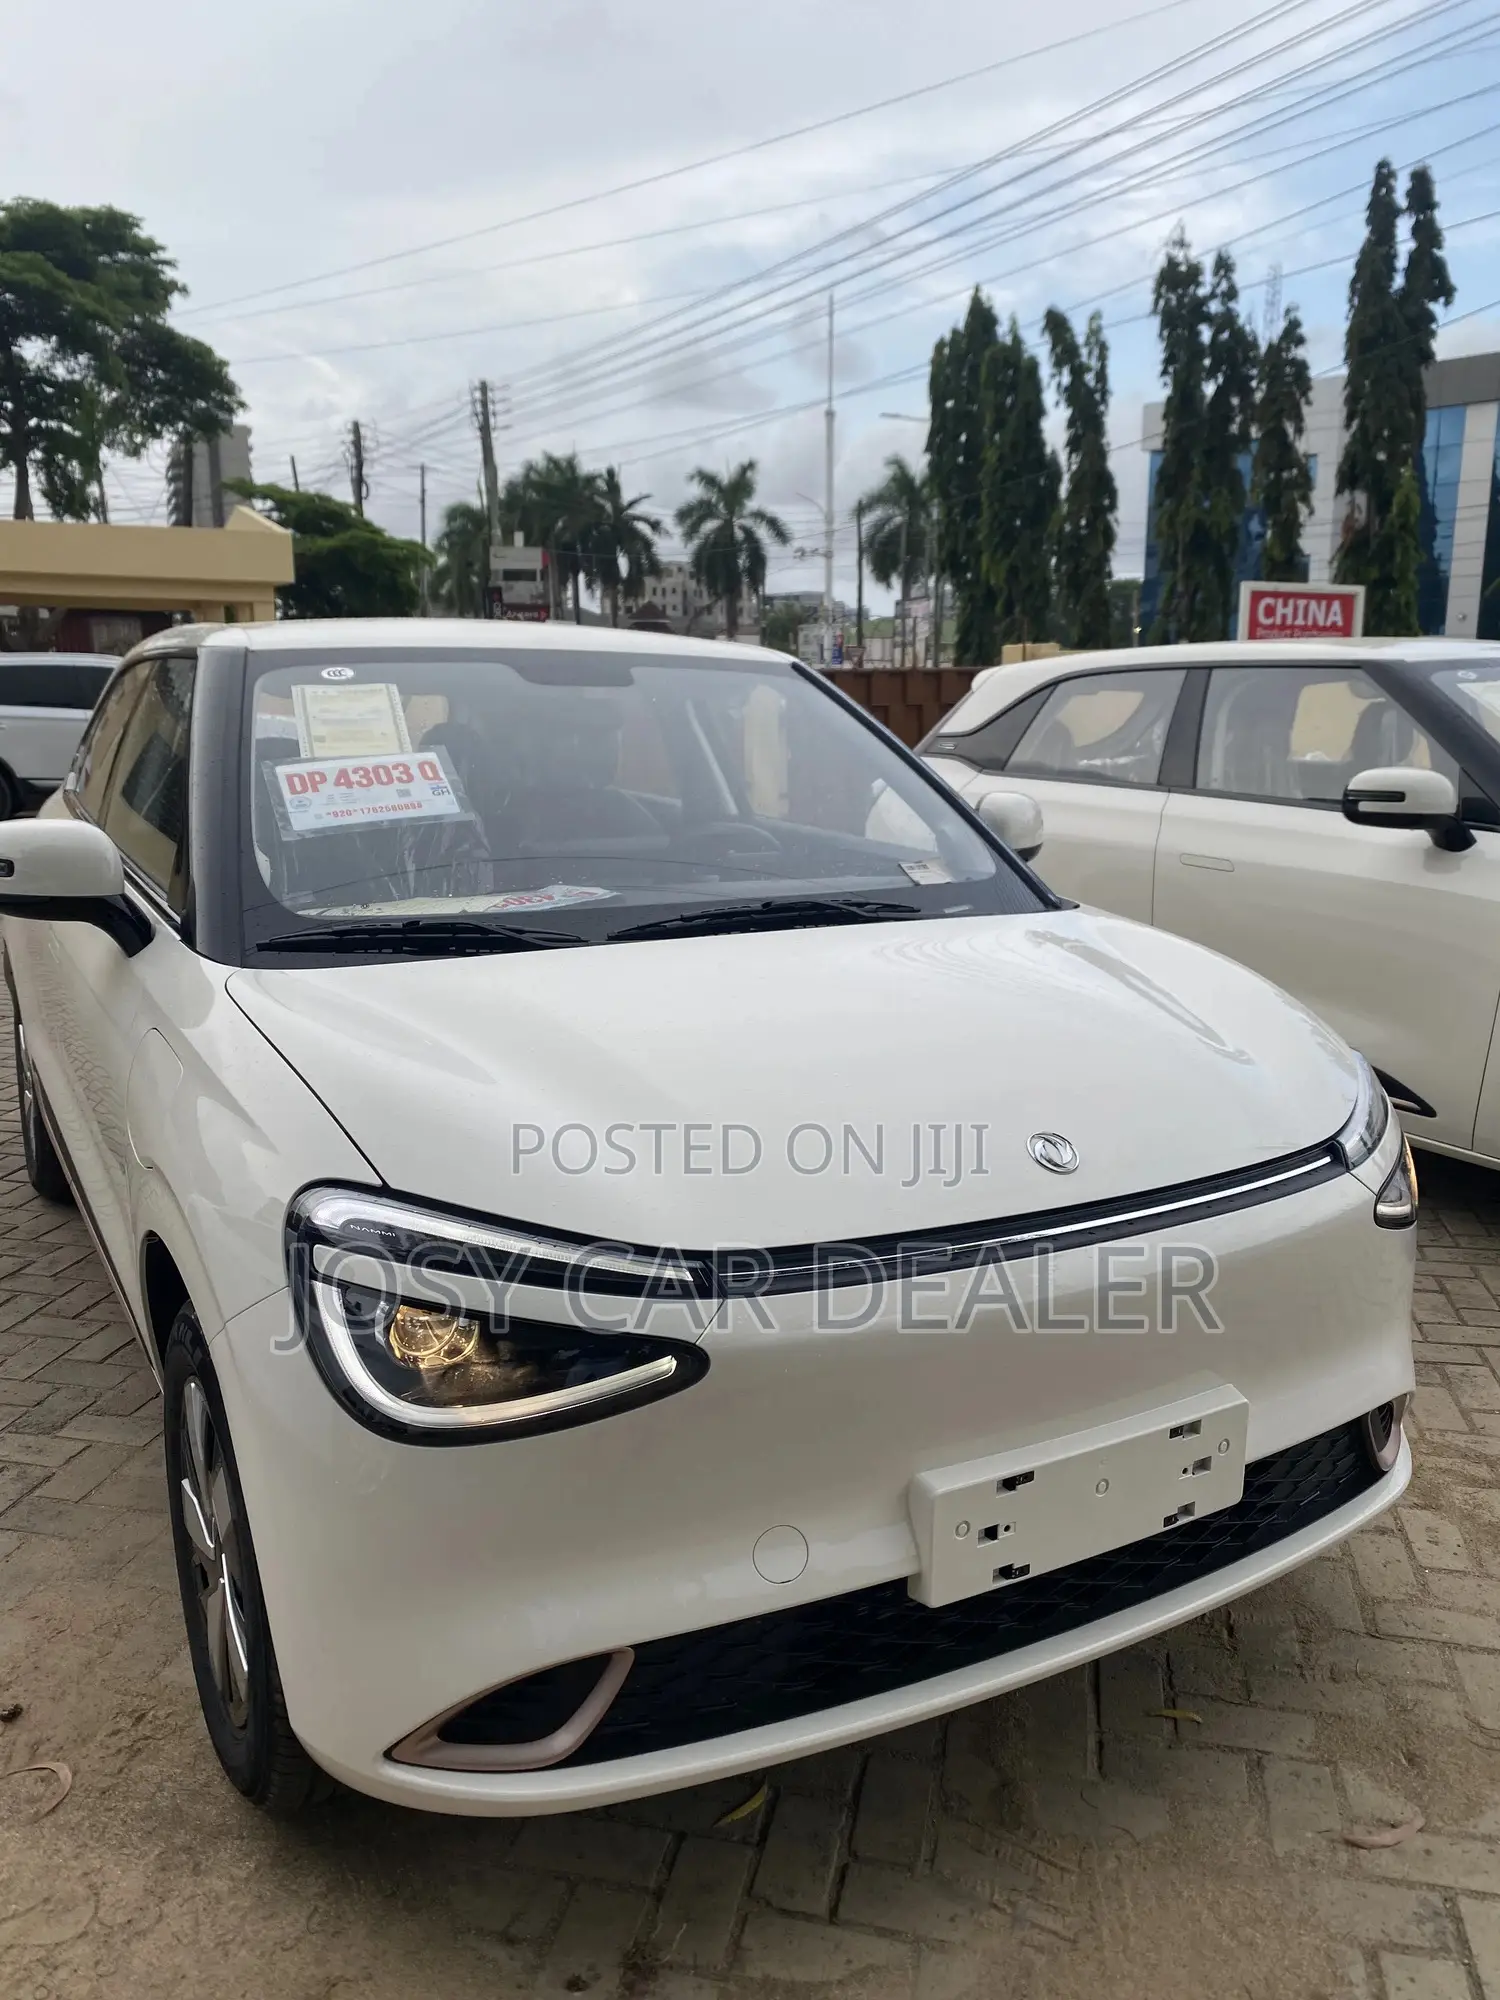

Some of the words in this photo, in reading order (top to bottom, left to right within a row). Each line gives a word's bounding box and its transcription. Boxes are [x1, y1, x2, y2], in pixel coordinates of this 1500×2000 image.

[1257, 597, 1343, 626] CHINA
[285, 770, 328, 796] DP
[334, 762, 415, 790] 4303
[418, 760, 443, 782] Q
[431, 788, 451, 797] GH
[350, 1224, 396, 1237] NAMMI
